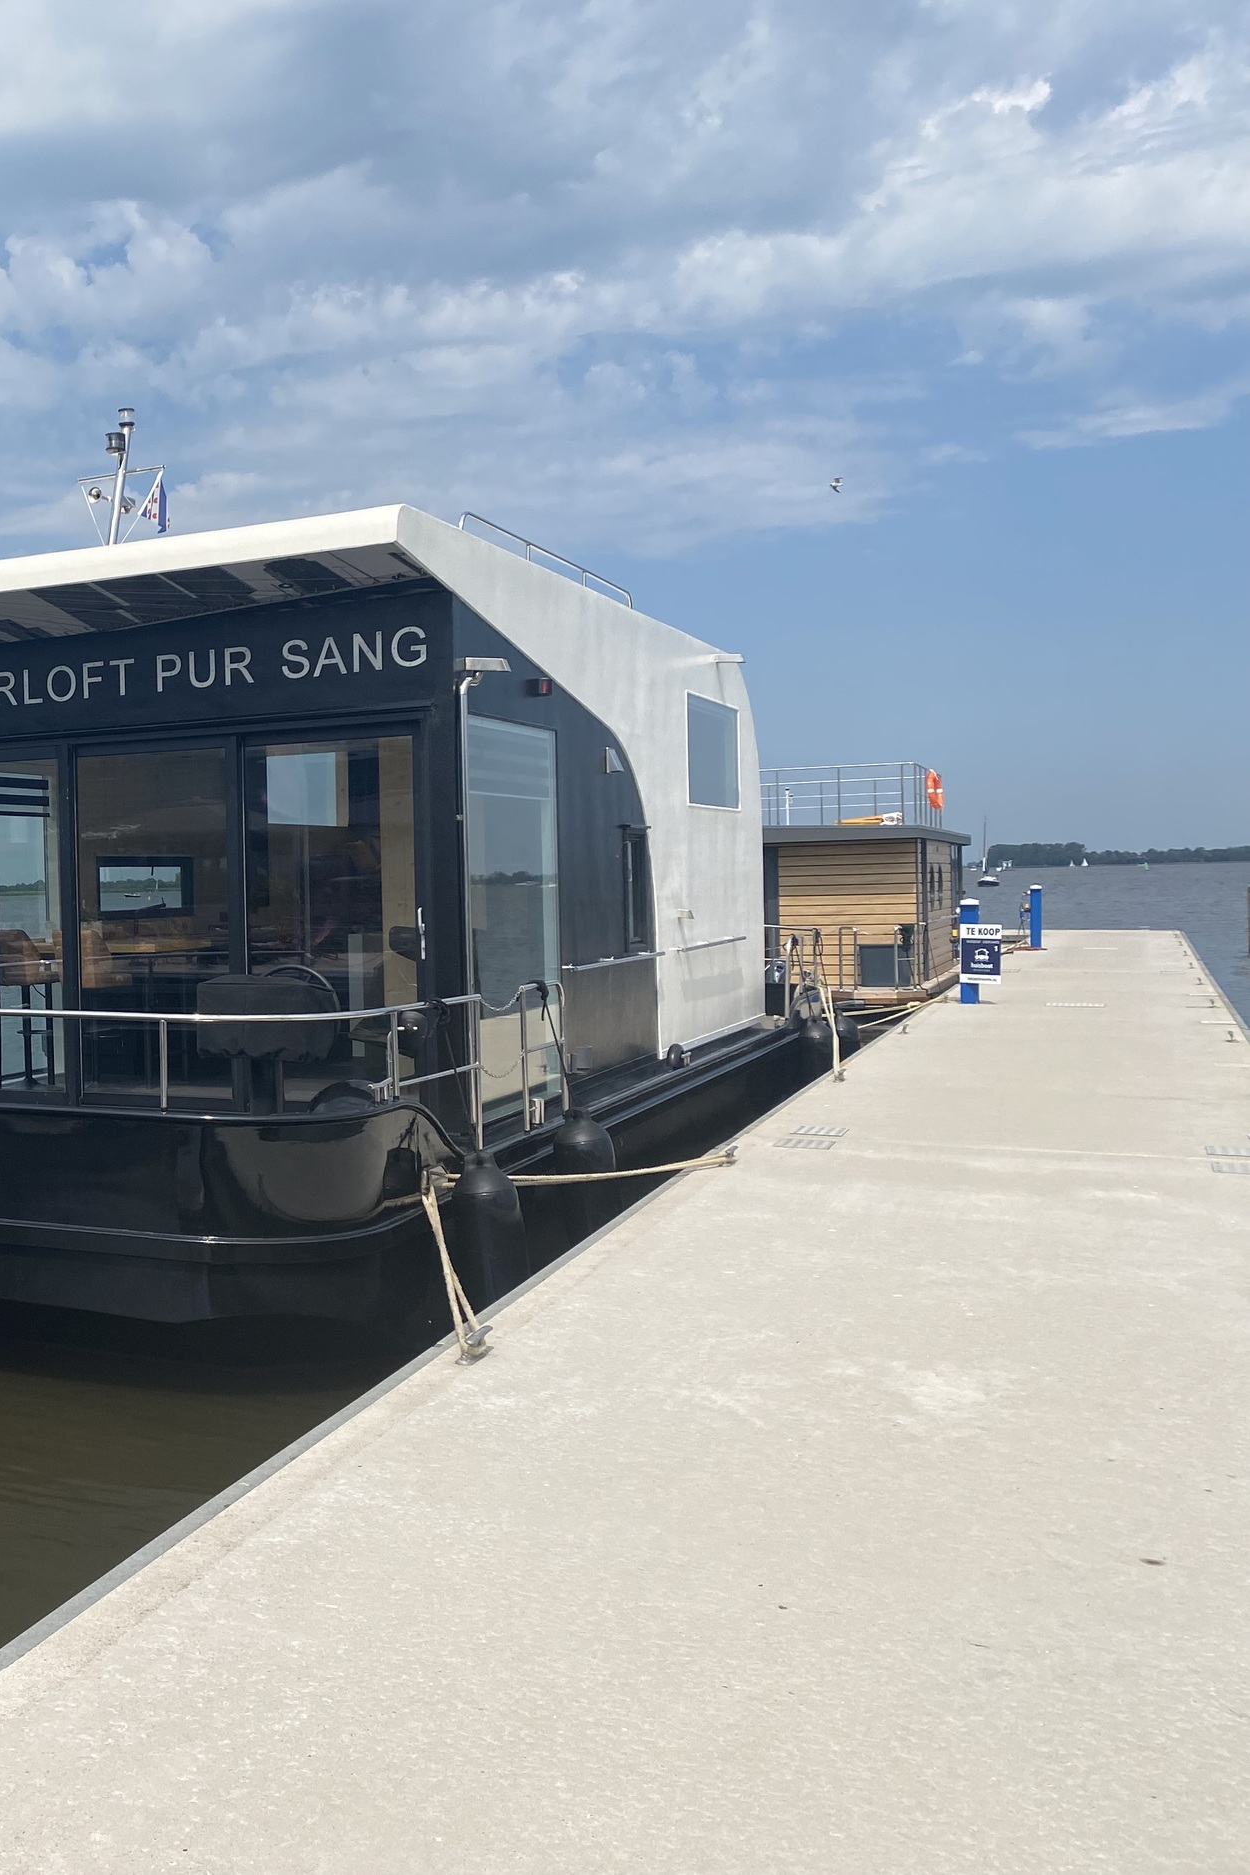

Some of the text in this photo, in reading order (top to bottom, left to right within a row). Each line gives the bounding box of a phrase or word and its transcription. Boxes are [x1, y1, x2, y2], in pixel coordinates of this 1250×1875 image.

[156, 646, 254, 692] PUR
[281, 626, 428, 679] SANG
[966, 927, 1000, 936] TE KOOP
